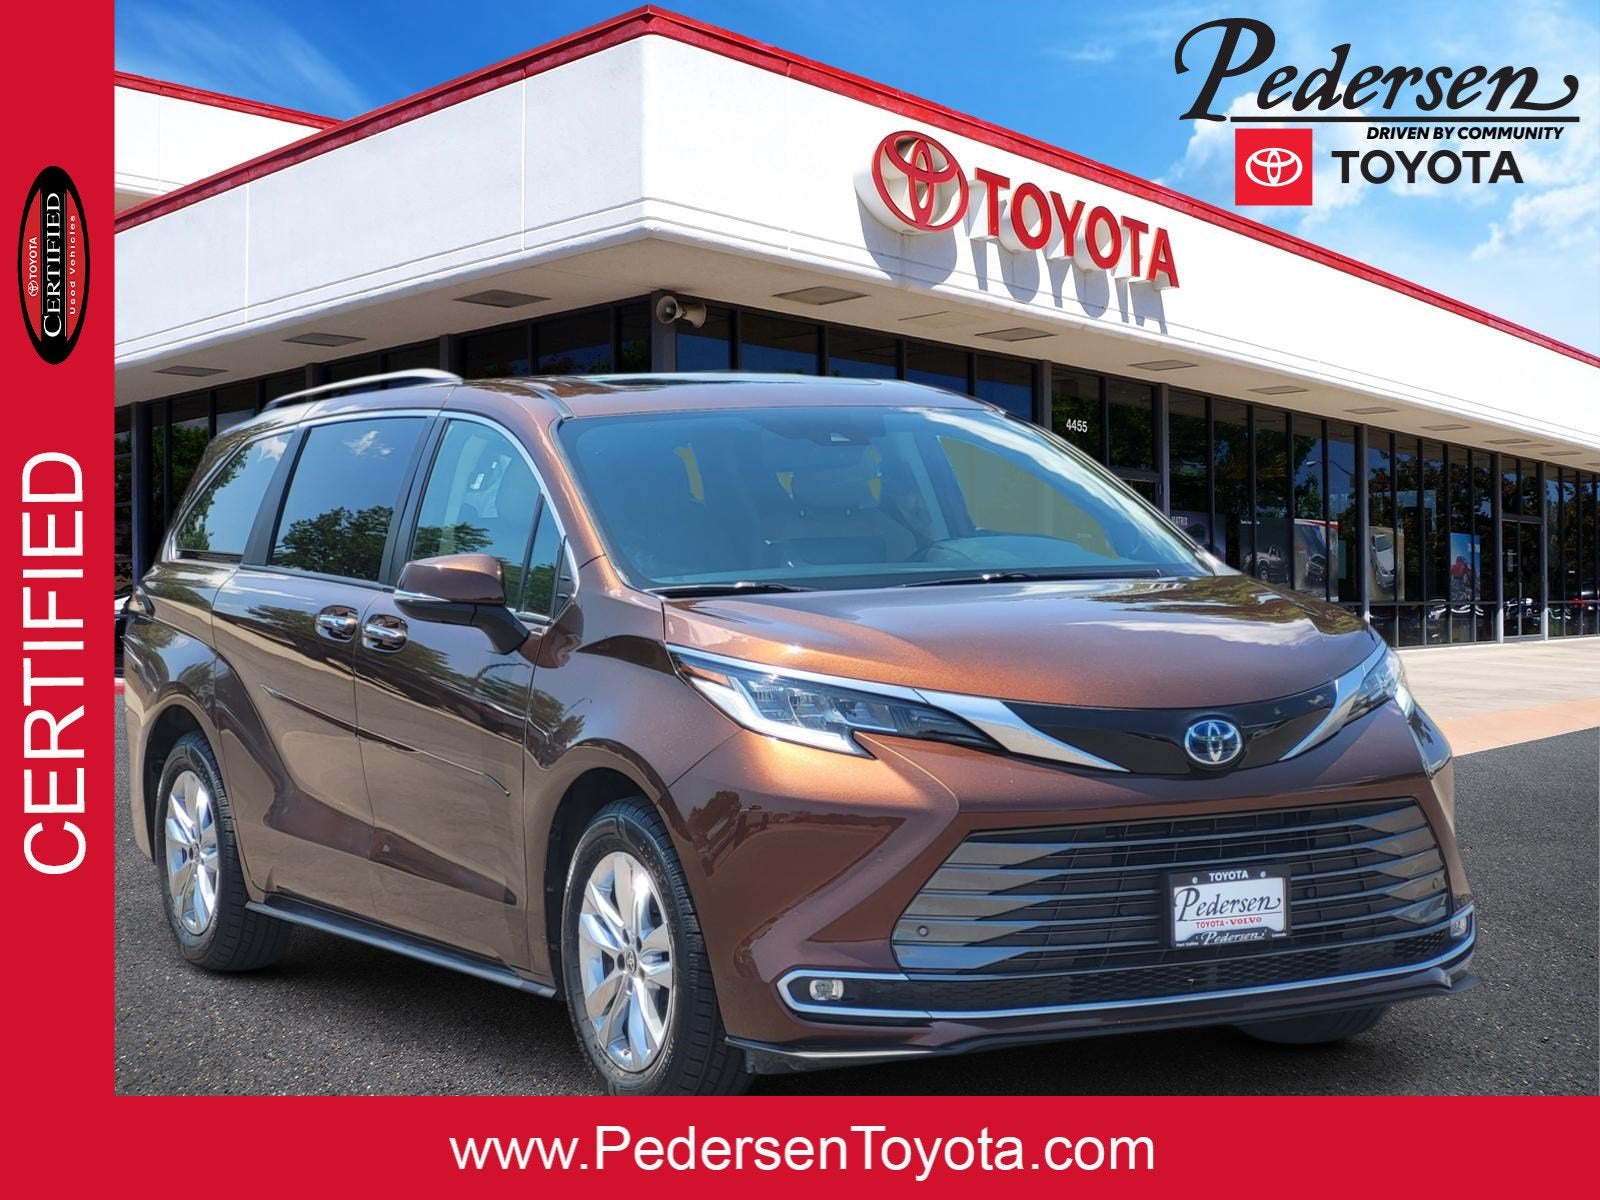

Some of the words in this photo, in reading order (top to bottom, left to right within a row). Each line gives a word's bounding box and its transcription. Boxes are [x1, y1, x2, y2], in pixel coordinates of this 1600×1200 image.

[975, 167, 1180, 288] TOYOTA
[1065, 418, 1088, 433] 4455
[1209, 870, 1249, 882] TOYOTA
[1174, 887, 1281, 922] Pedersen
[1196, 920, 1225, 929] TOYOTA
[1229, 916, 1262, 926] VOLVO
[1200, 931, 1265, 946] Pedersen
